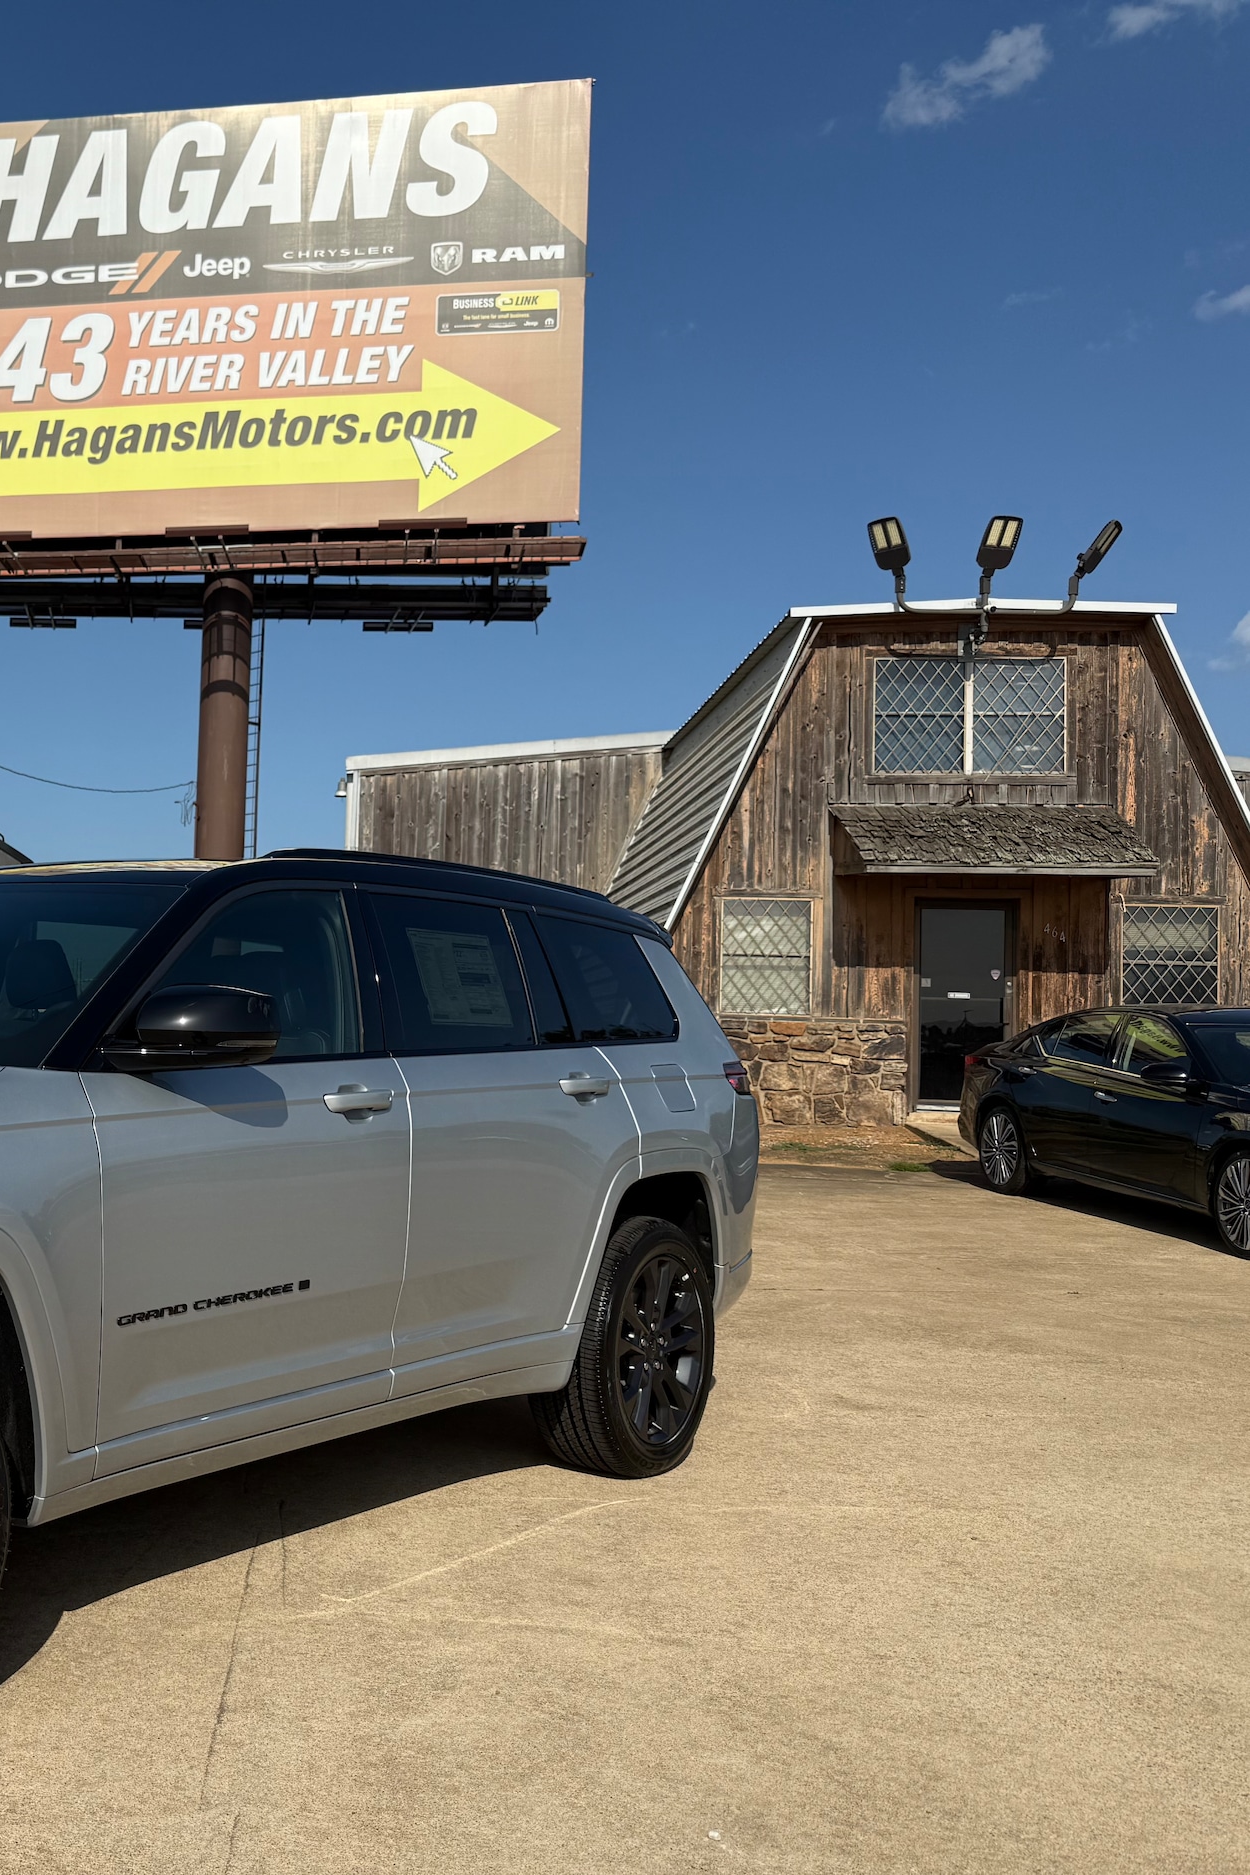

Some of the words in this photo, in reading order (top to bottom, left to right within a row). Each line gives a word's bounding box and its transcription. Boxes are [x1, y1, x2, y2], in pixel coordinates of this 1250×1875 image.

[282, 246, 394, 260] CHRYSLER
[471, 245, 566, 264] RAM
[183, 253, 251, 280] Jeep
[452, 297, 495, 310] BUSINESS
[514, 295, 539, 307] LINK
[128, 304, 259, 348] YEARS
[269, 301, 319, 340] IN
[330, 296, 410, 337] THE
[121, 352, 245, 397] RIVER
[258, 344, 415, 388] VALLEY
[1043, 922, 1067, 943] 464
[116, 1303, 188, 1328] GRAND
[193, 1282, 294, 1311] CHEROKEE
